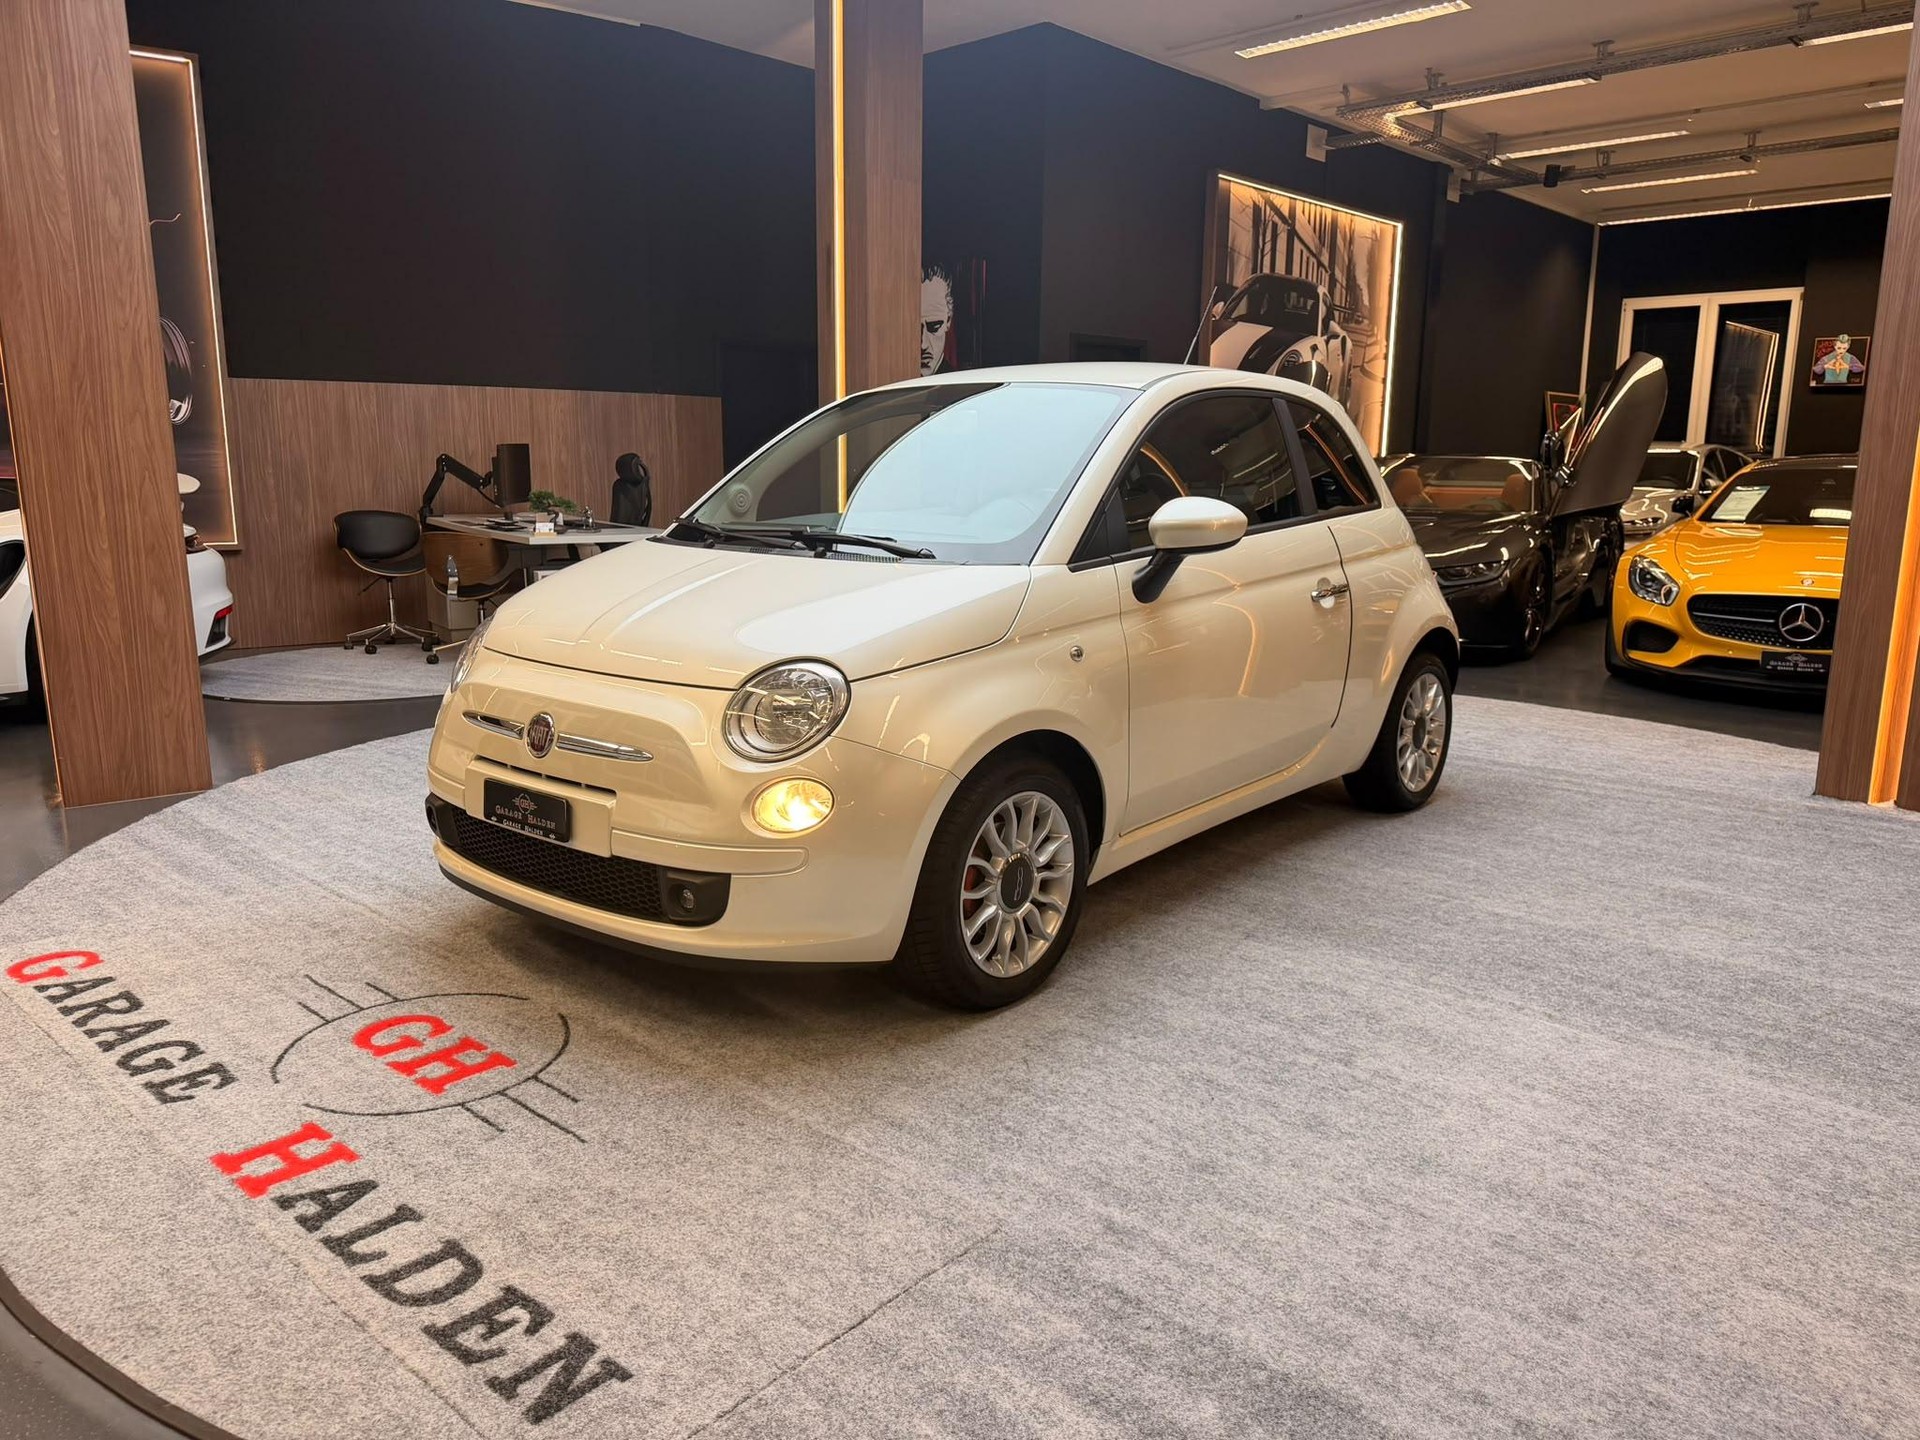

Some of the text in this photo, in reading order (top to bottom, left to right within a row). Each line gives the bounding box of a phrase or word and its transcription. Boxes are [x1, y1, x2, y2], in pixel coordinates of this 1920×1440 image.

[530, 725, 549, 746] FIAT
[495, 805, 522, 820] GARAGE
[350, 1013, 518, 1095] GH
[6, 950, 633, 1425] GARAGE HALDEN
